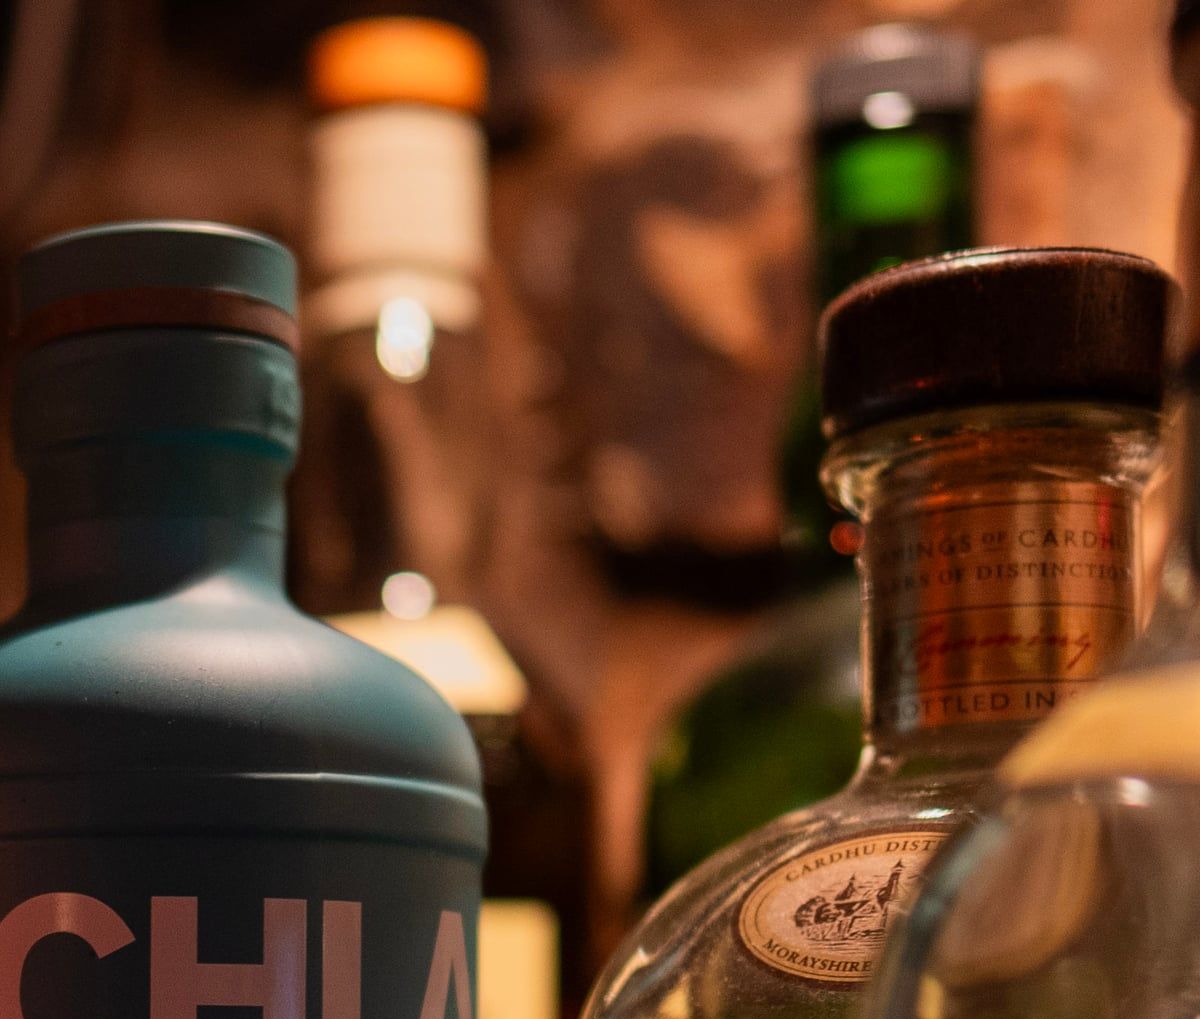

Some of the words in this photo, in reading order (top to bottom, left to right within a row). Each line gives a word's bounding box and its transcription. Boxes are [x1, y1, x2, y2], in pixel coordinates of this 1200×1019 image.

[940, 566, 965, 585] OF
[1026, 690, 1056, 709] IN
[786, 843, 876, 882] CARDHU
[762, 937, 872, 973] MORAYSHIRE
